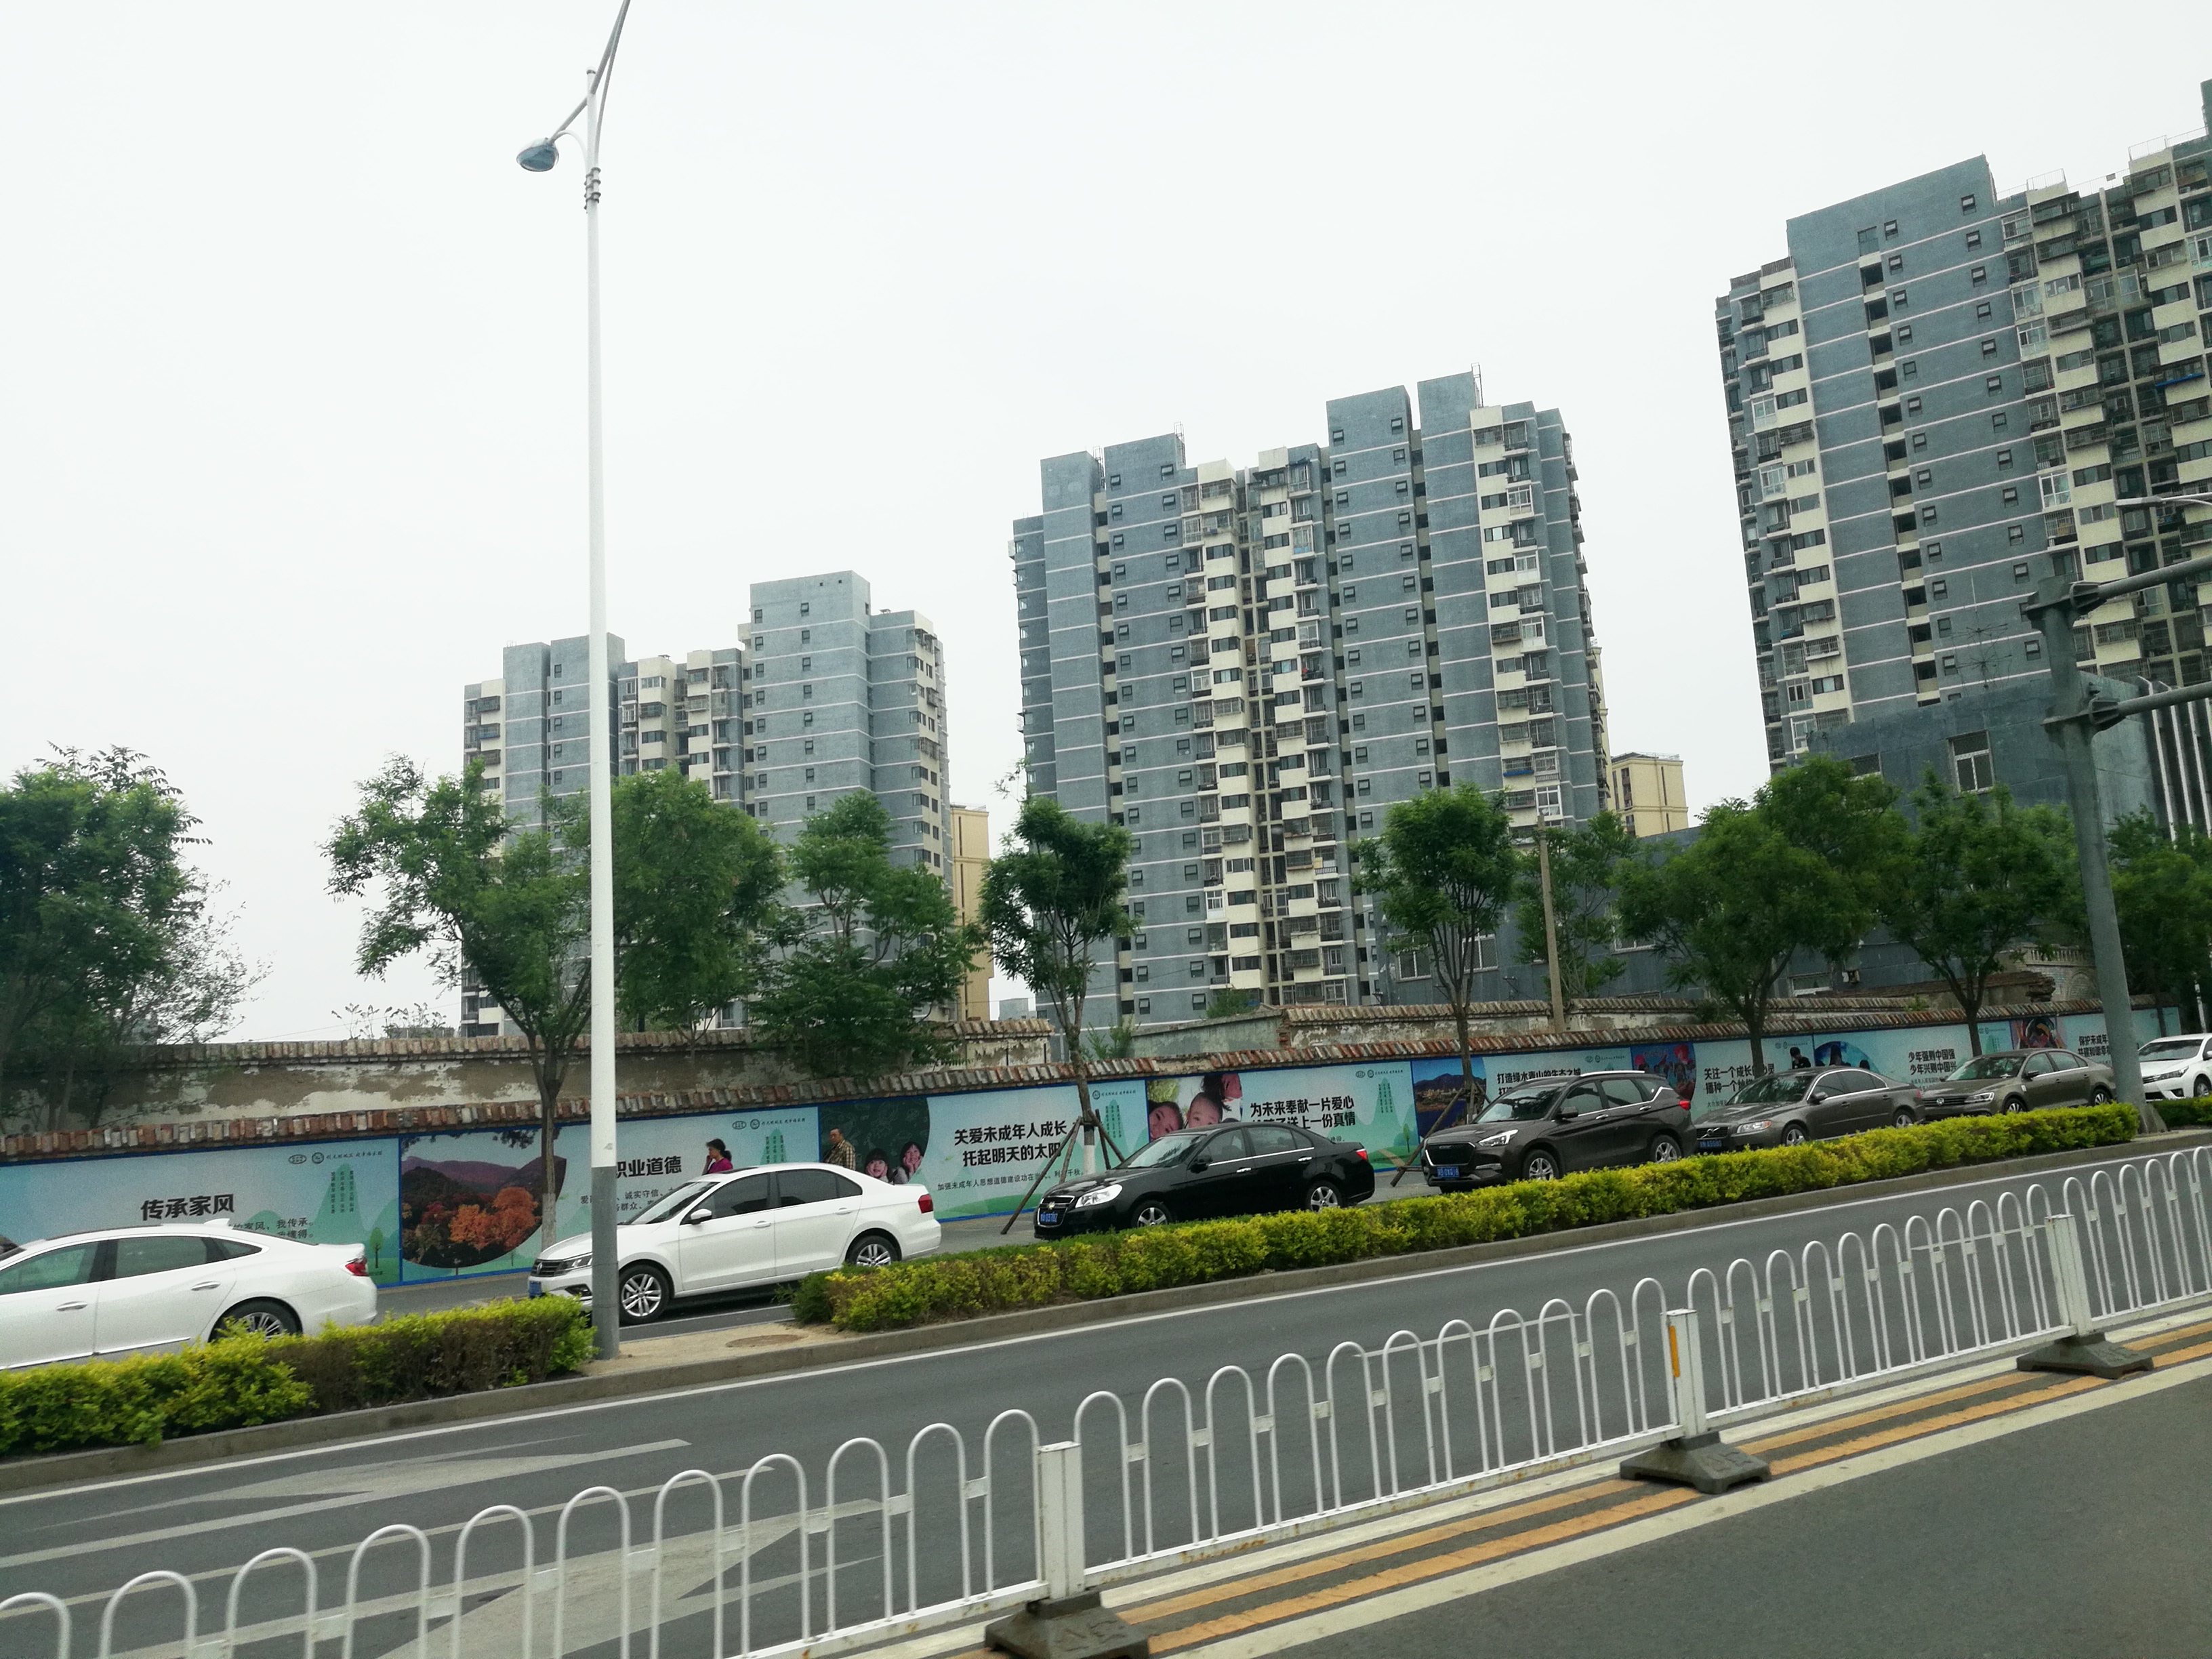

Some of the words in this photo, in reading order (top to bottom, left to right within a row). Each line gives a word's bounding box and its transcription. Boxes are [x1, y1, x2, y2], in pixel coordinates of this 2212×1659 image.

[1908, 1048, 1956, 1063] 少年强则中国强
[1704, 1063, 1775, 1080] 关注一个成长灵
[1910, 1061, 1957, 1075] 少年兴则中国兴
[1250, 1095, 1355, 1118] 为未来奉献一片爱心
[954, 1120, 1067, 1146] 关爱未成年人成长
[962, 1143, 1061, 1167] 托起明天的太阳
[140, 1193, 234, 1221] 传承家风
